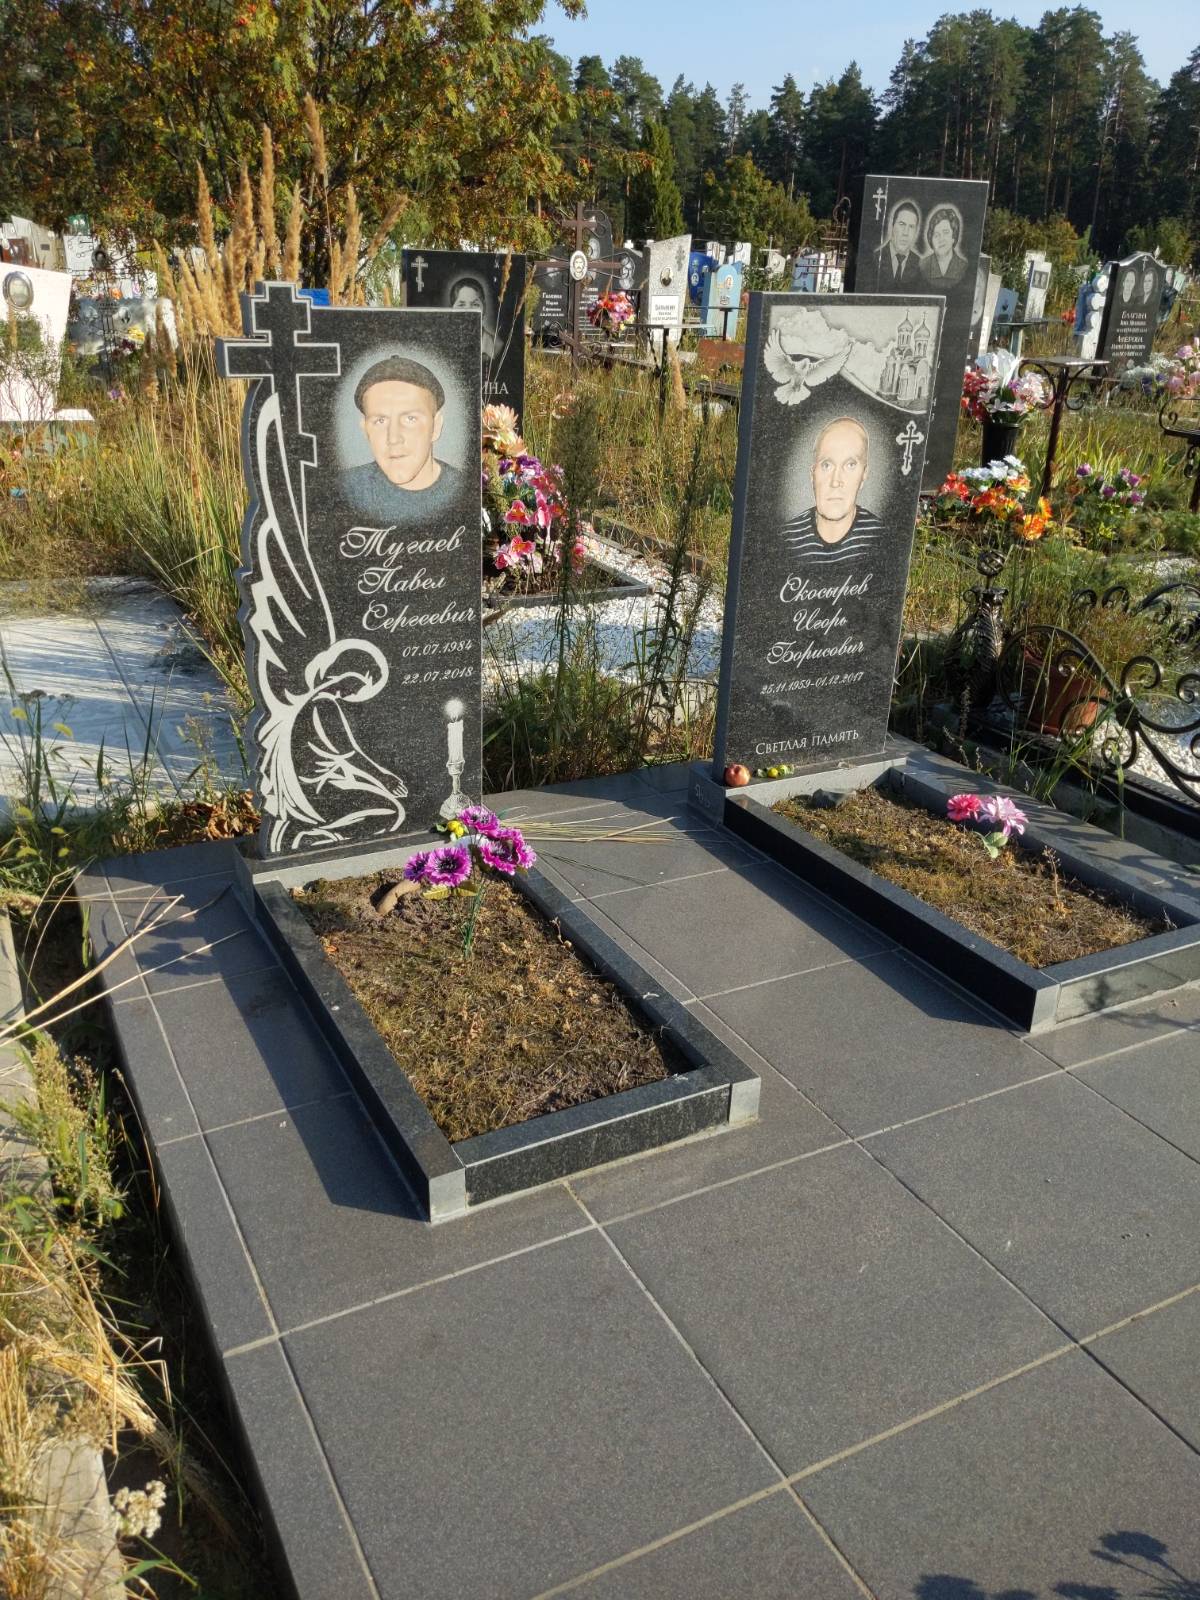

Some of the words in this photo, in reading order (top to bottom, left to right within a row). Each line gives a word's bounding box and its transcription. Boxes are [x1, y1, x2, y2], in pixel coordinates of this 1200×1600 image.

[340, 525, 466, 567] Тугаев
[357, 566, 446, 594] Павел
[780, 572, 874, 606] Скосырев
[362, 600, 476, 633] Сергеевич
[793, 607, 848, 636] Игорь
[402, 639, 473, 658] 07.07.1984
[766, 635, 865, 669] Борисович
[401, 666, 474, 685] 22.07.2018
